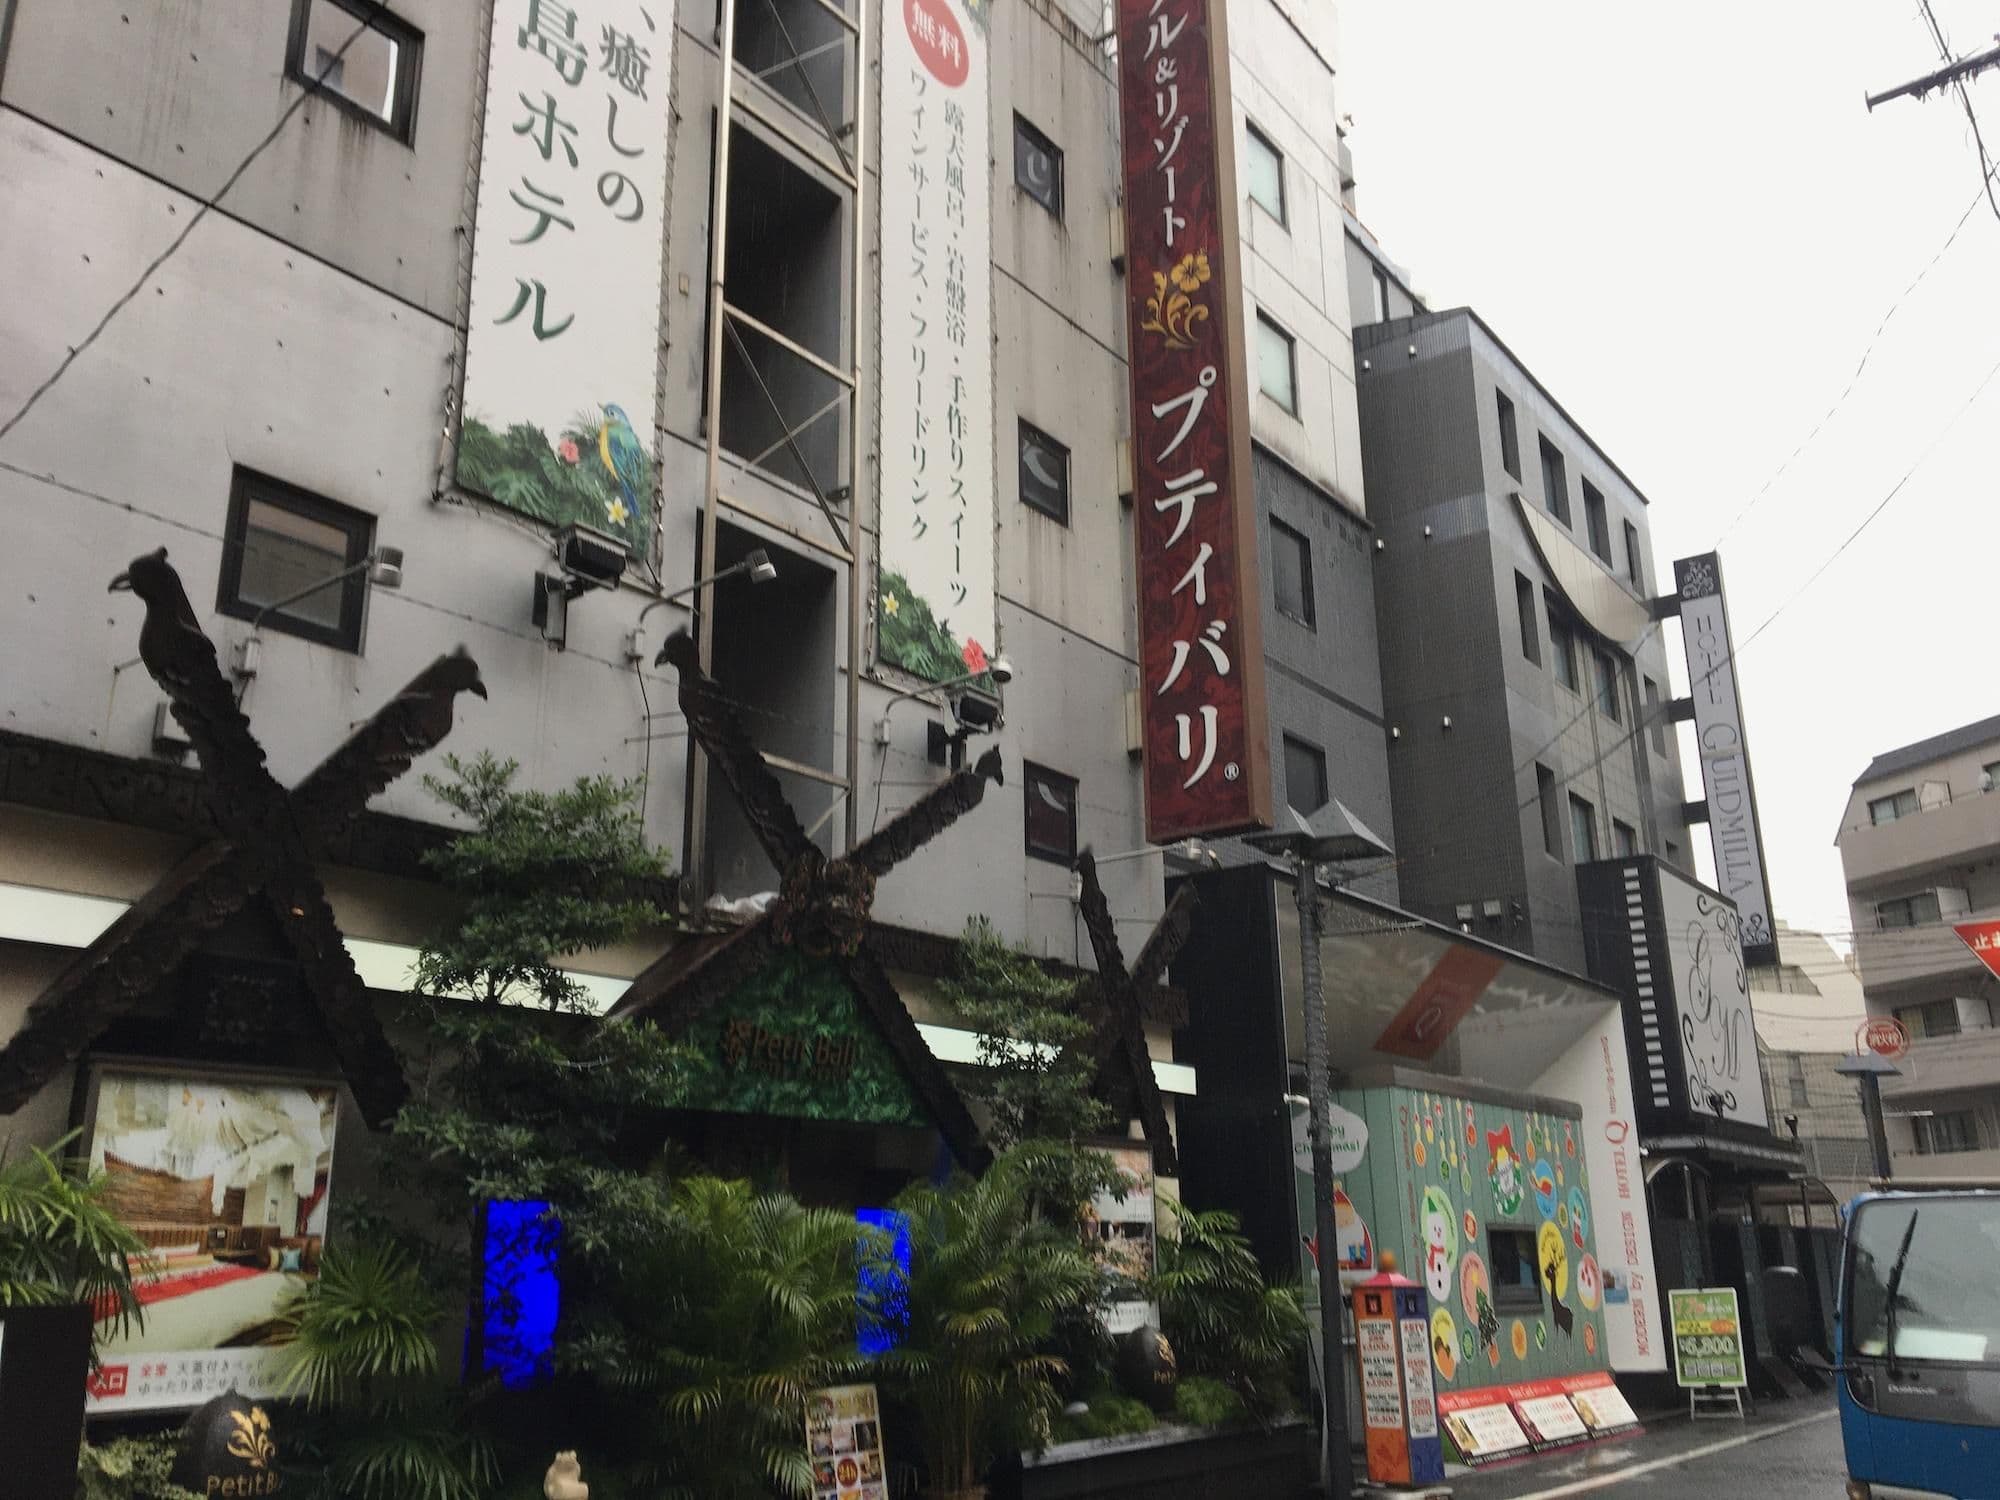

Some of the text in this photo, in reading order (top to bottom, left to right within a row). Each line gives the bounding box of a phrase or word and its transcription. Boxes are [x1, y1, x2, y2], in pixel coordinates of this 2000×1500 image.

[912, 1, 960, 68] 無料
[1144, 0, 1191, 248] ル&リゾート
[909, 68, 929, 541] ワインサービス・フリードリンク
[1151, 366, 1232, 790] プティバリ
[1702, 722, 1754, 895] GULDMILLA
[94, 1372, 123, 1390] 入口
